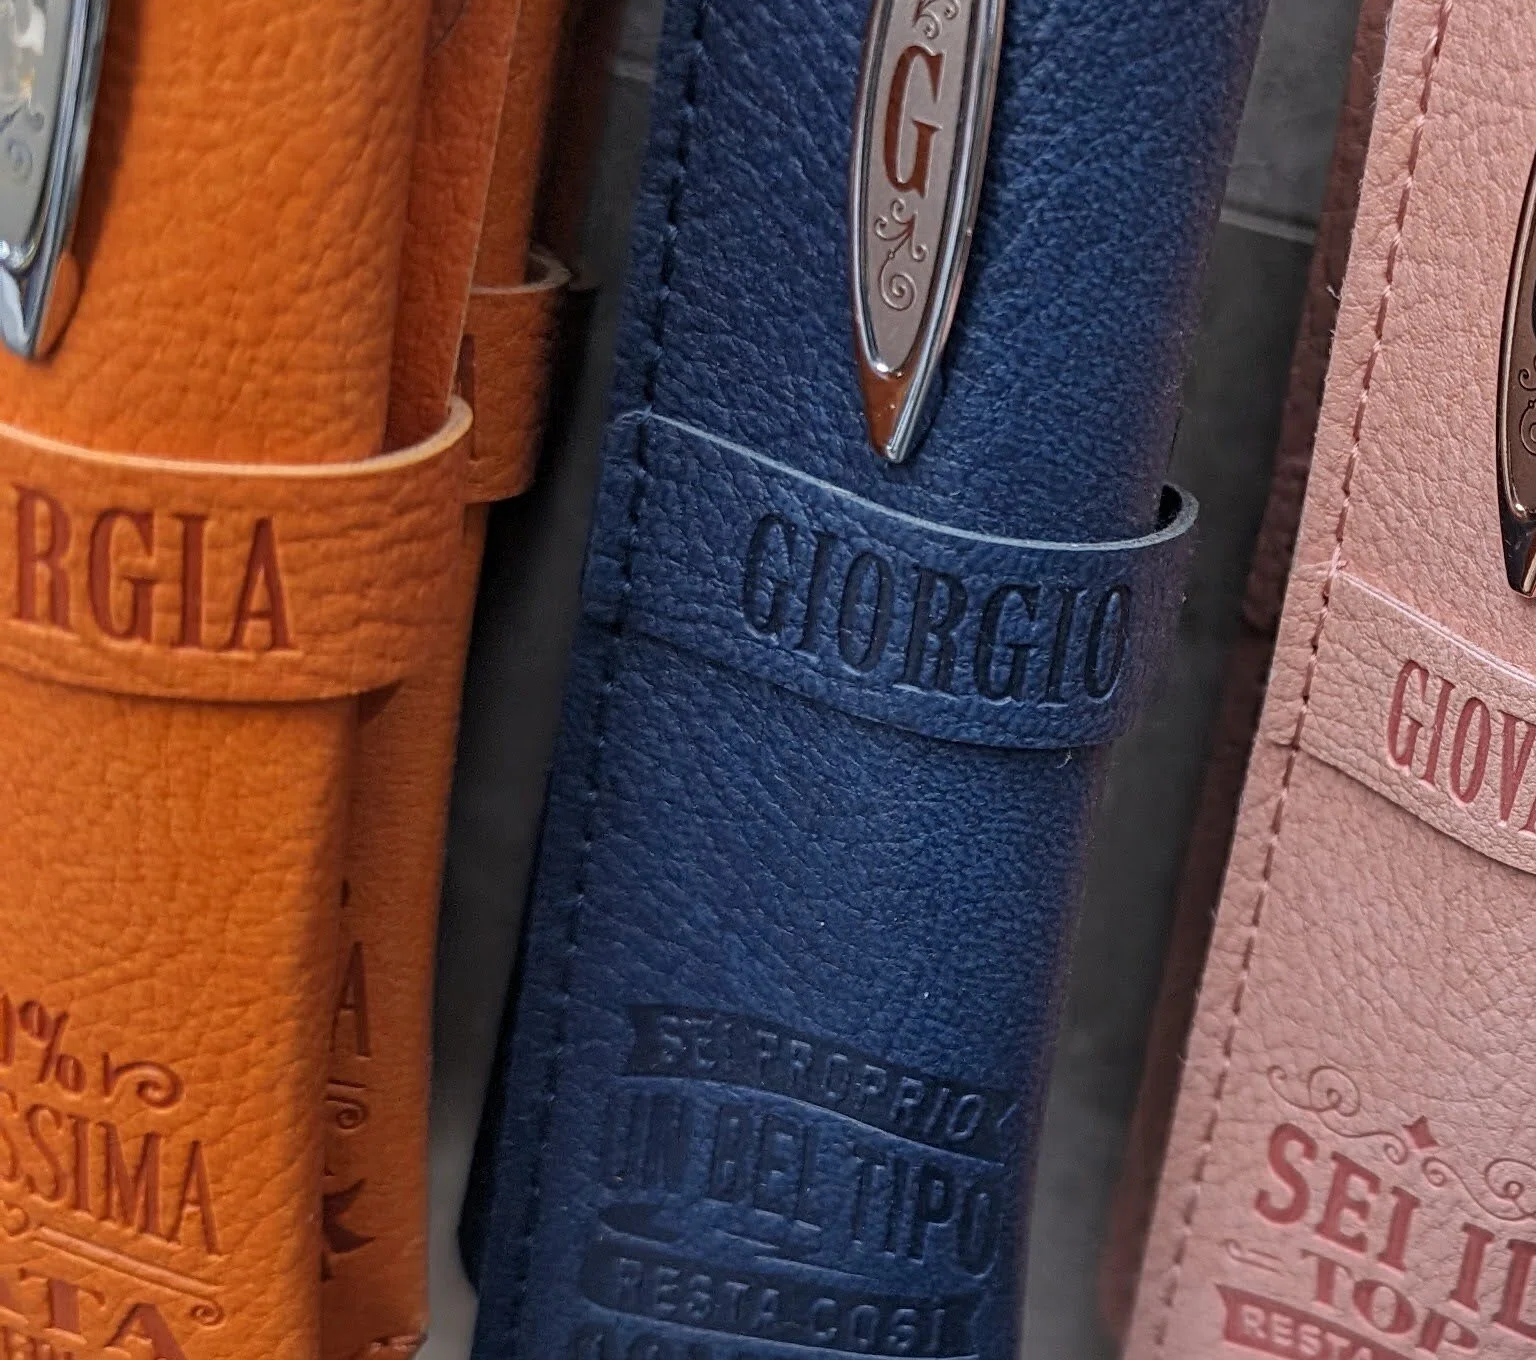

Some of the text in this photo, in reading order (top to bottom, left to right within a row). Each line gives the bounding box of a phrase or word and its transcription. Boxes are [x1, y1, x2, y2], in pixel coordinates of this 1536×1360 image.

[883, 43, 944, 195] G
[742, 512, 1132, 707] GIORGIO
[755, 1030, 987, 1142] PROPRIO
[848, 1140, 1001, 1280] TIPO
[1253, 1122, 1420, 1273] SEI
[613, 1254, 781, 1330] RESTA
[1300, 1248, 1481, 1356] TOP
